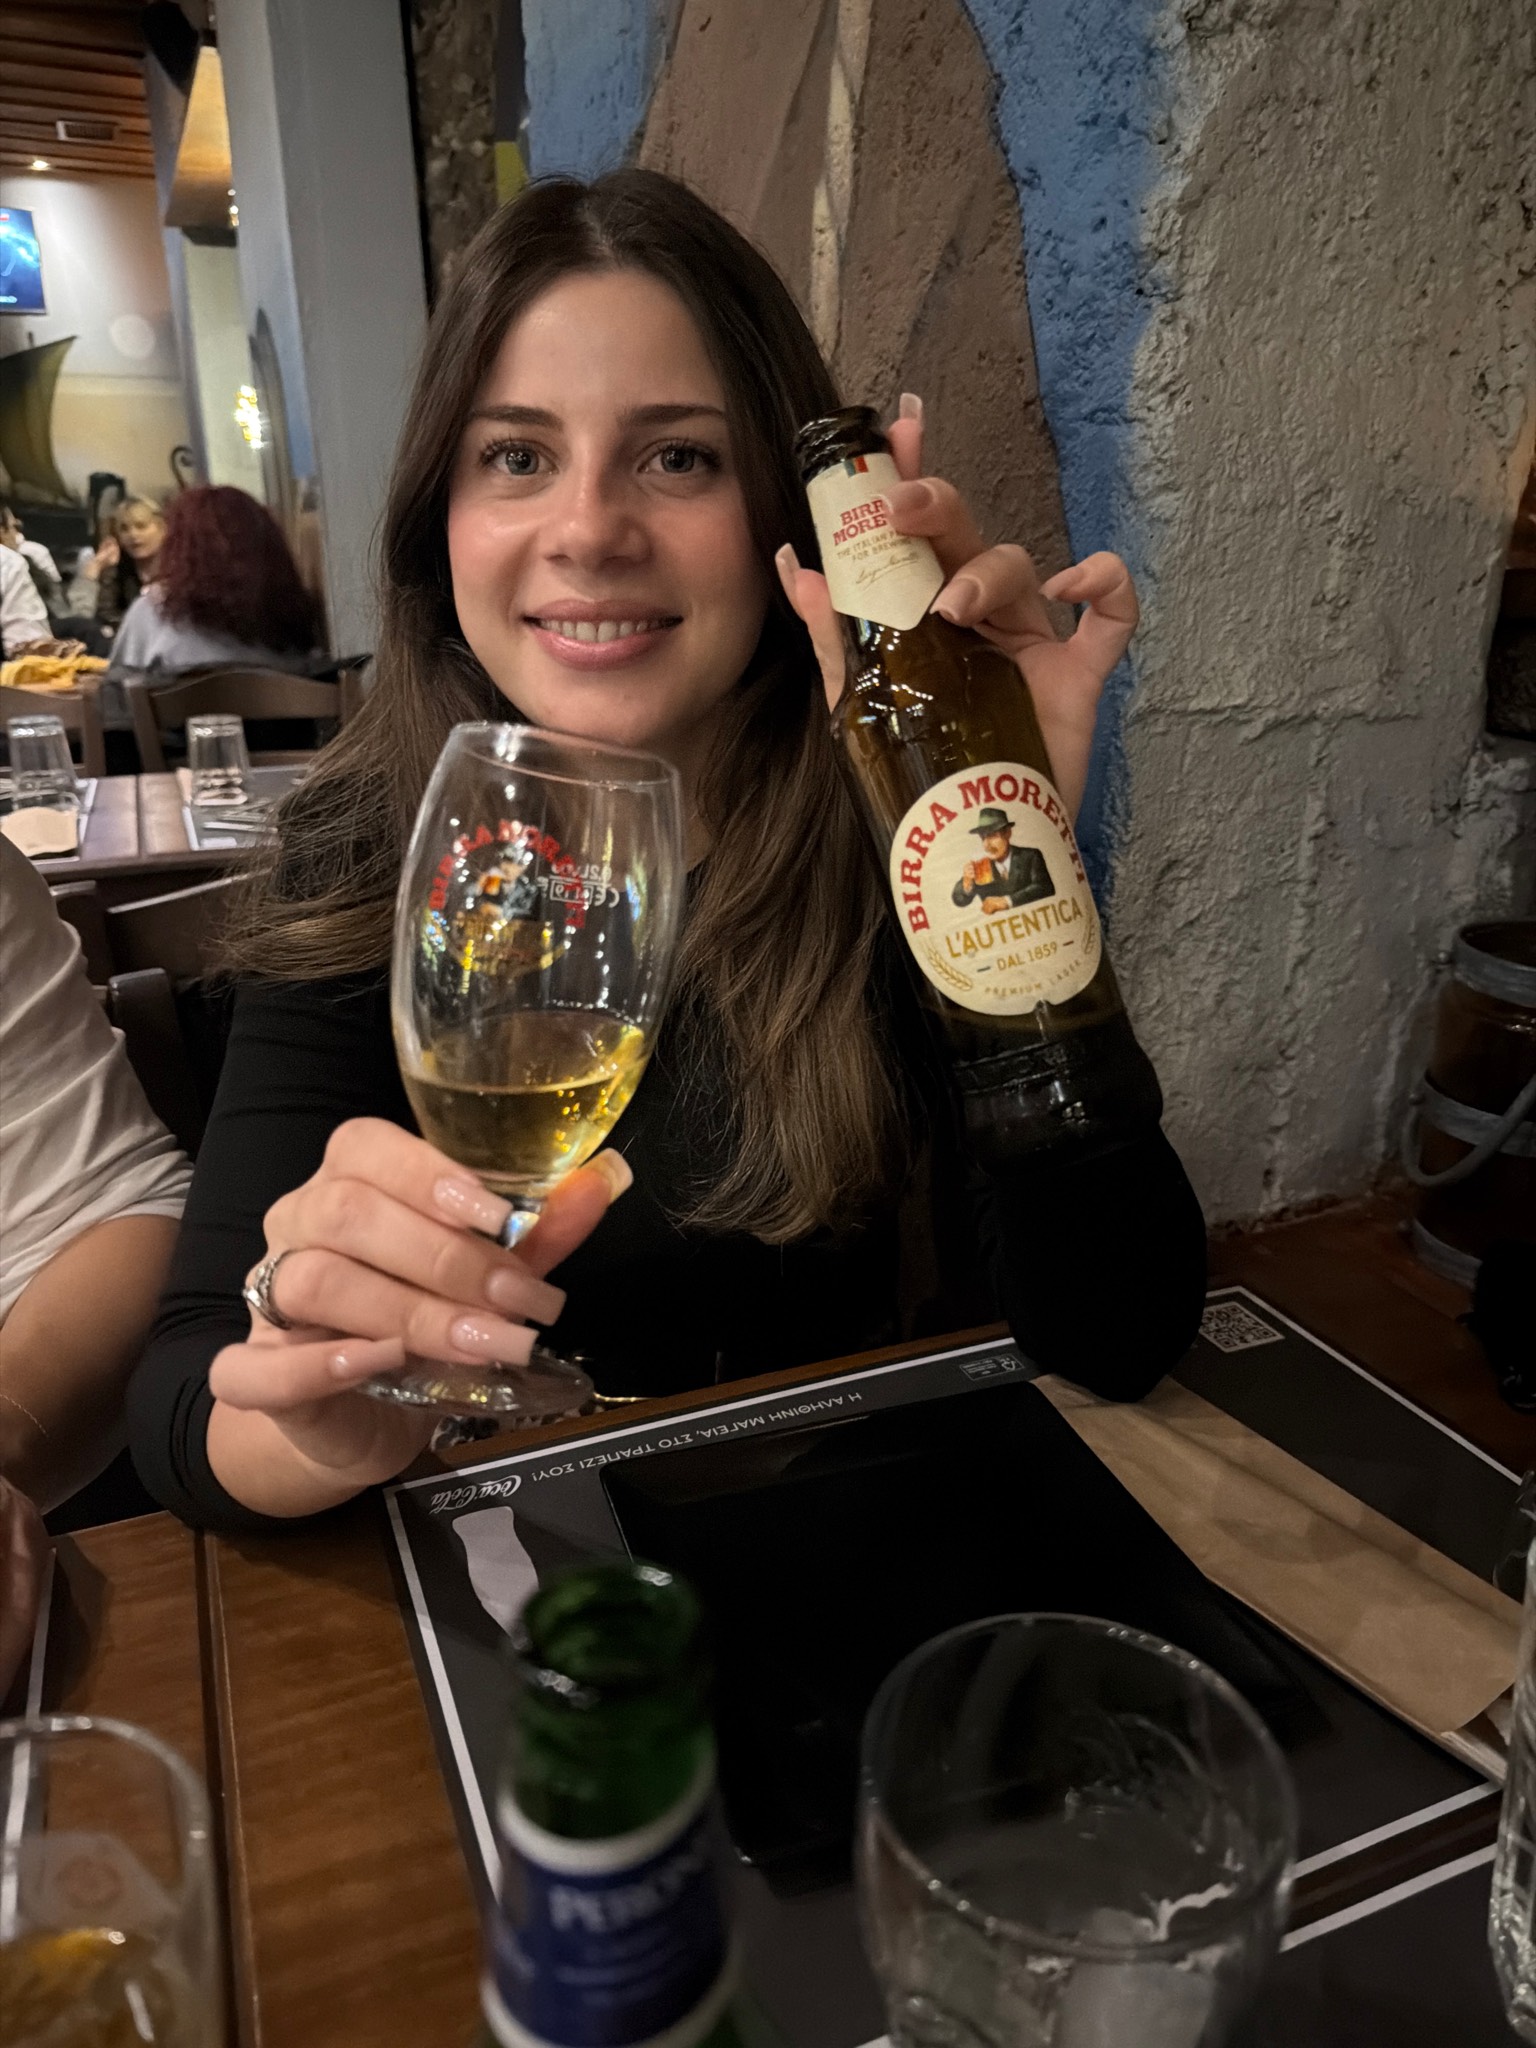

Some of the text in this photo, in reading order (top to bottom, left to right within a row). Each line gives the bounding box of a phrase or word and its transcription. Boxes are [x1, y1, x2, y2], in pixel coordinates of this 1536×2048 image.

[840, 499, 884, 526] BIRR
[832, 513, 888, 546] MORE
[900, 773, 1086, 933] BIRRA MORETTI
[945, 897, 1084, 959] L'AUTENTICA
[996, 941, 1058, 972] DAL 1859
[768, 1398, 846, 1422] ΑΛΗΘΙΝΗ
[696, 1415, 766, 1438] ΜΑΓΕΙΑ,
[658, 1433, 695, 1449] ΣΤΟ
[578, 1442, 655, 1469] ΤΡΑΠΕΖΙ
